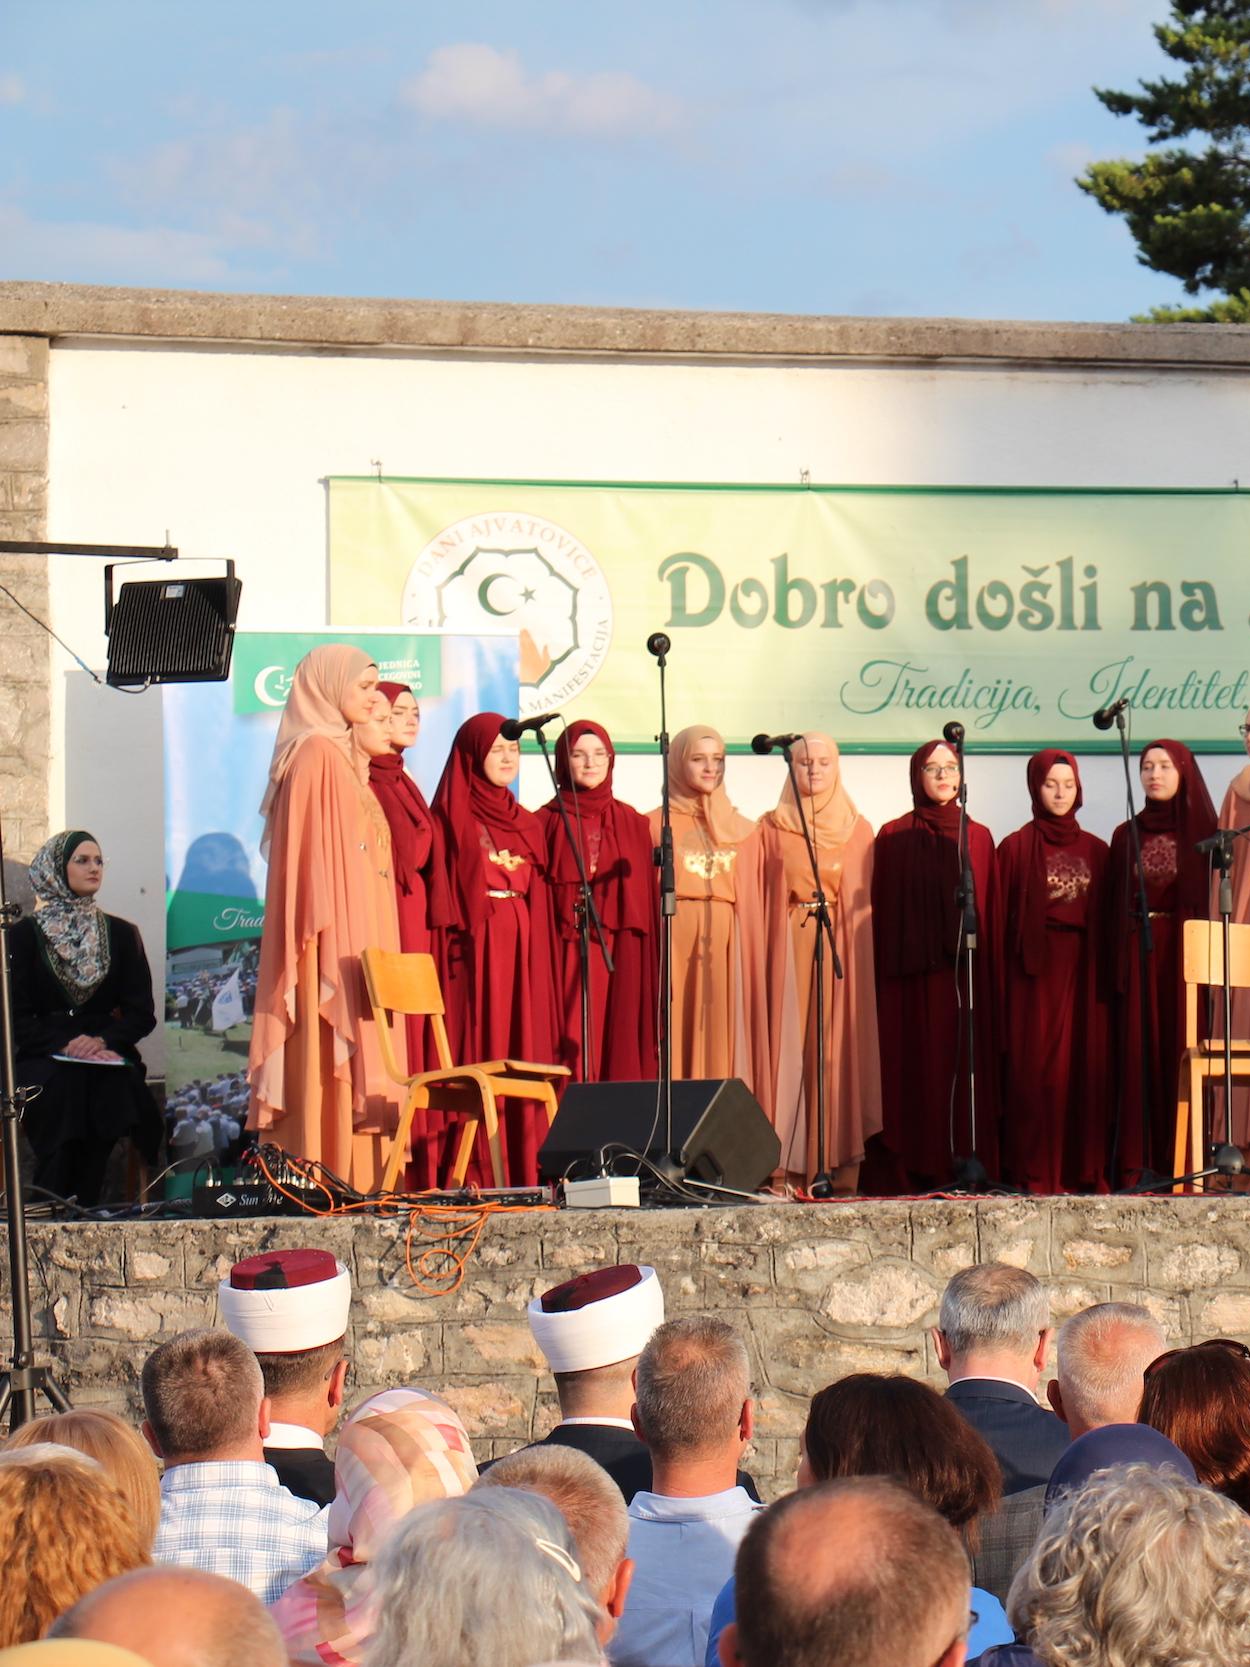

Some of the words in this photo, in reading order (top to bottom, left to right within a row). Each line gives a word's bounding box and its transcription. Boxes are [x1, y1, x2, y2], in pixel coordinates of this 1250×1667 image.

[417, 529, 464, 577] DANI
[470, 517, 598, 580] AJVATOVICE
[658, 551, 896, 630] Dobro
[925, 555, 1102, 631] došli
[1130, 579, 1225, 631] na
[378, 659, 420, 670] JEDNICA
[529, 619, 608, 712] MANIFESTACIJA
[840, 659, 1041, 730] Tradicija,
[1058, 656, 1249, 720] Identitet,
